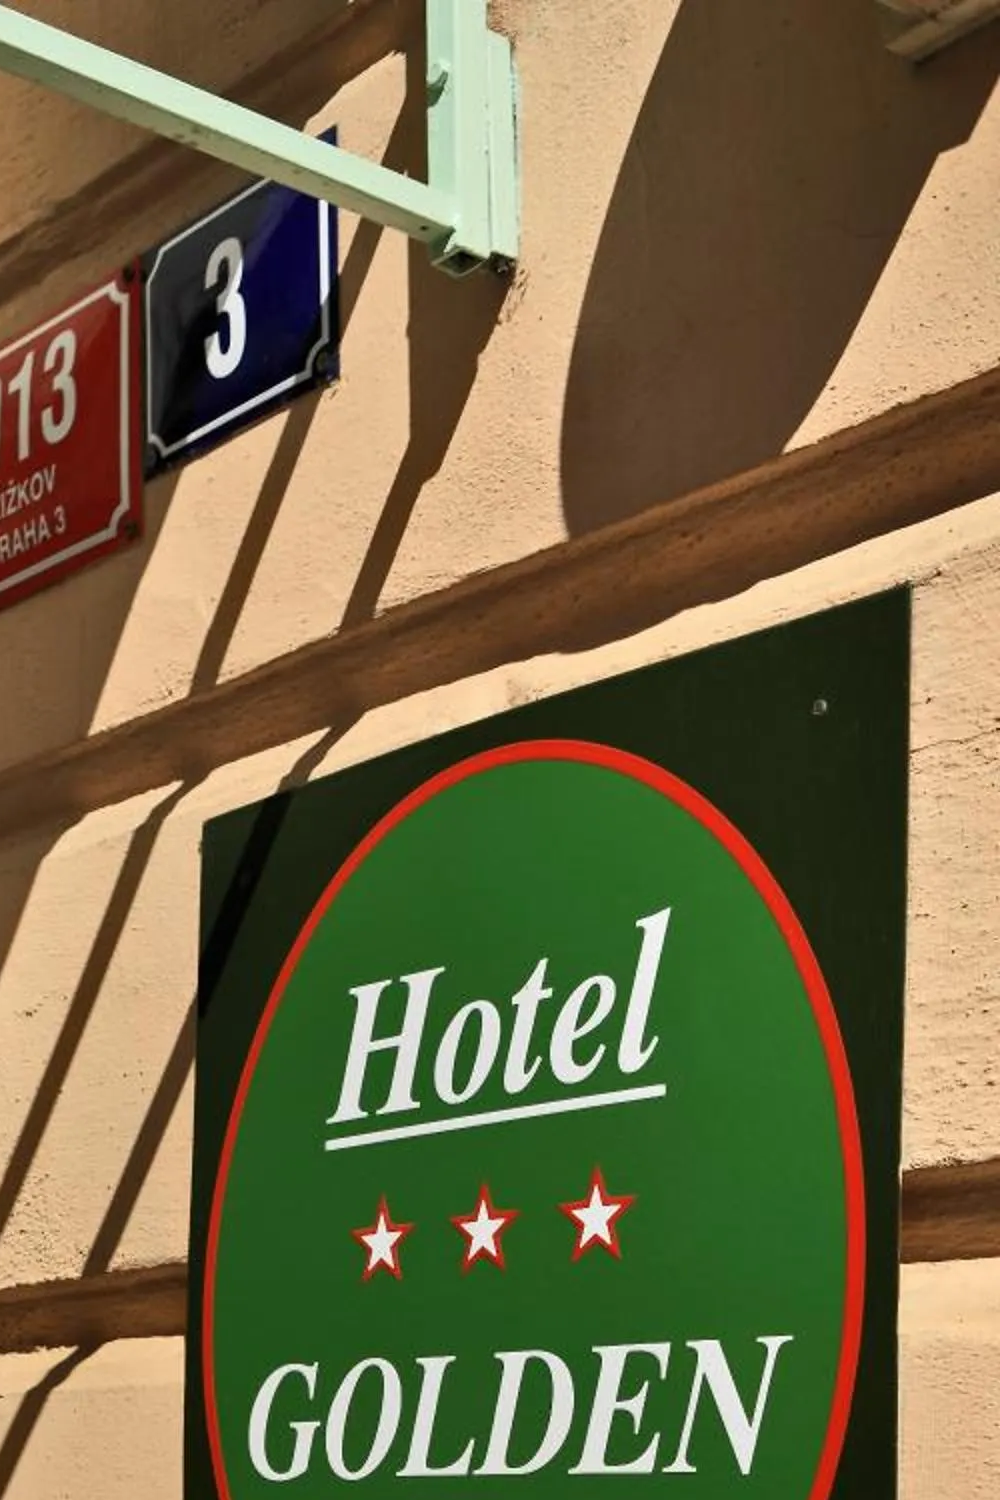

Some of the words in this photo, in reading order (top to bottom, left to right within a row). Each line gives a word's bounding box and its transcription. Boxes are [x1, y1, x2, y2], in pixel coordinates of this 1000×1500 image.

[203, 237, 247, 379] 3
[53, 504, 67, 535] 3
[325, 907, 671, 1125] Hotel
[247, 1335, 794, 1481] GOLDEN
